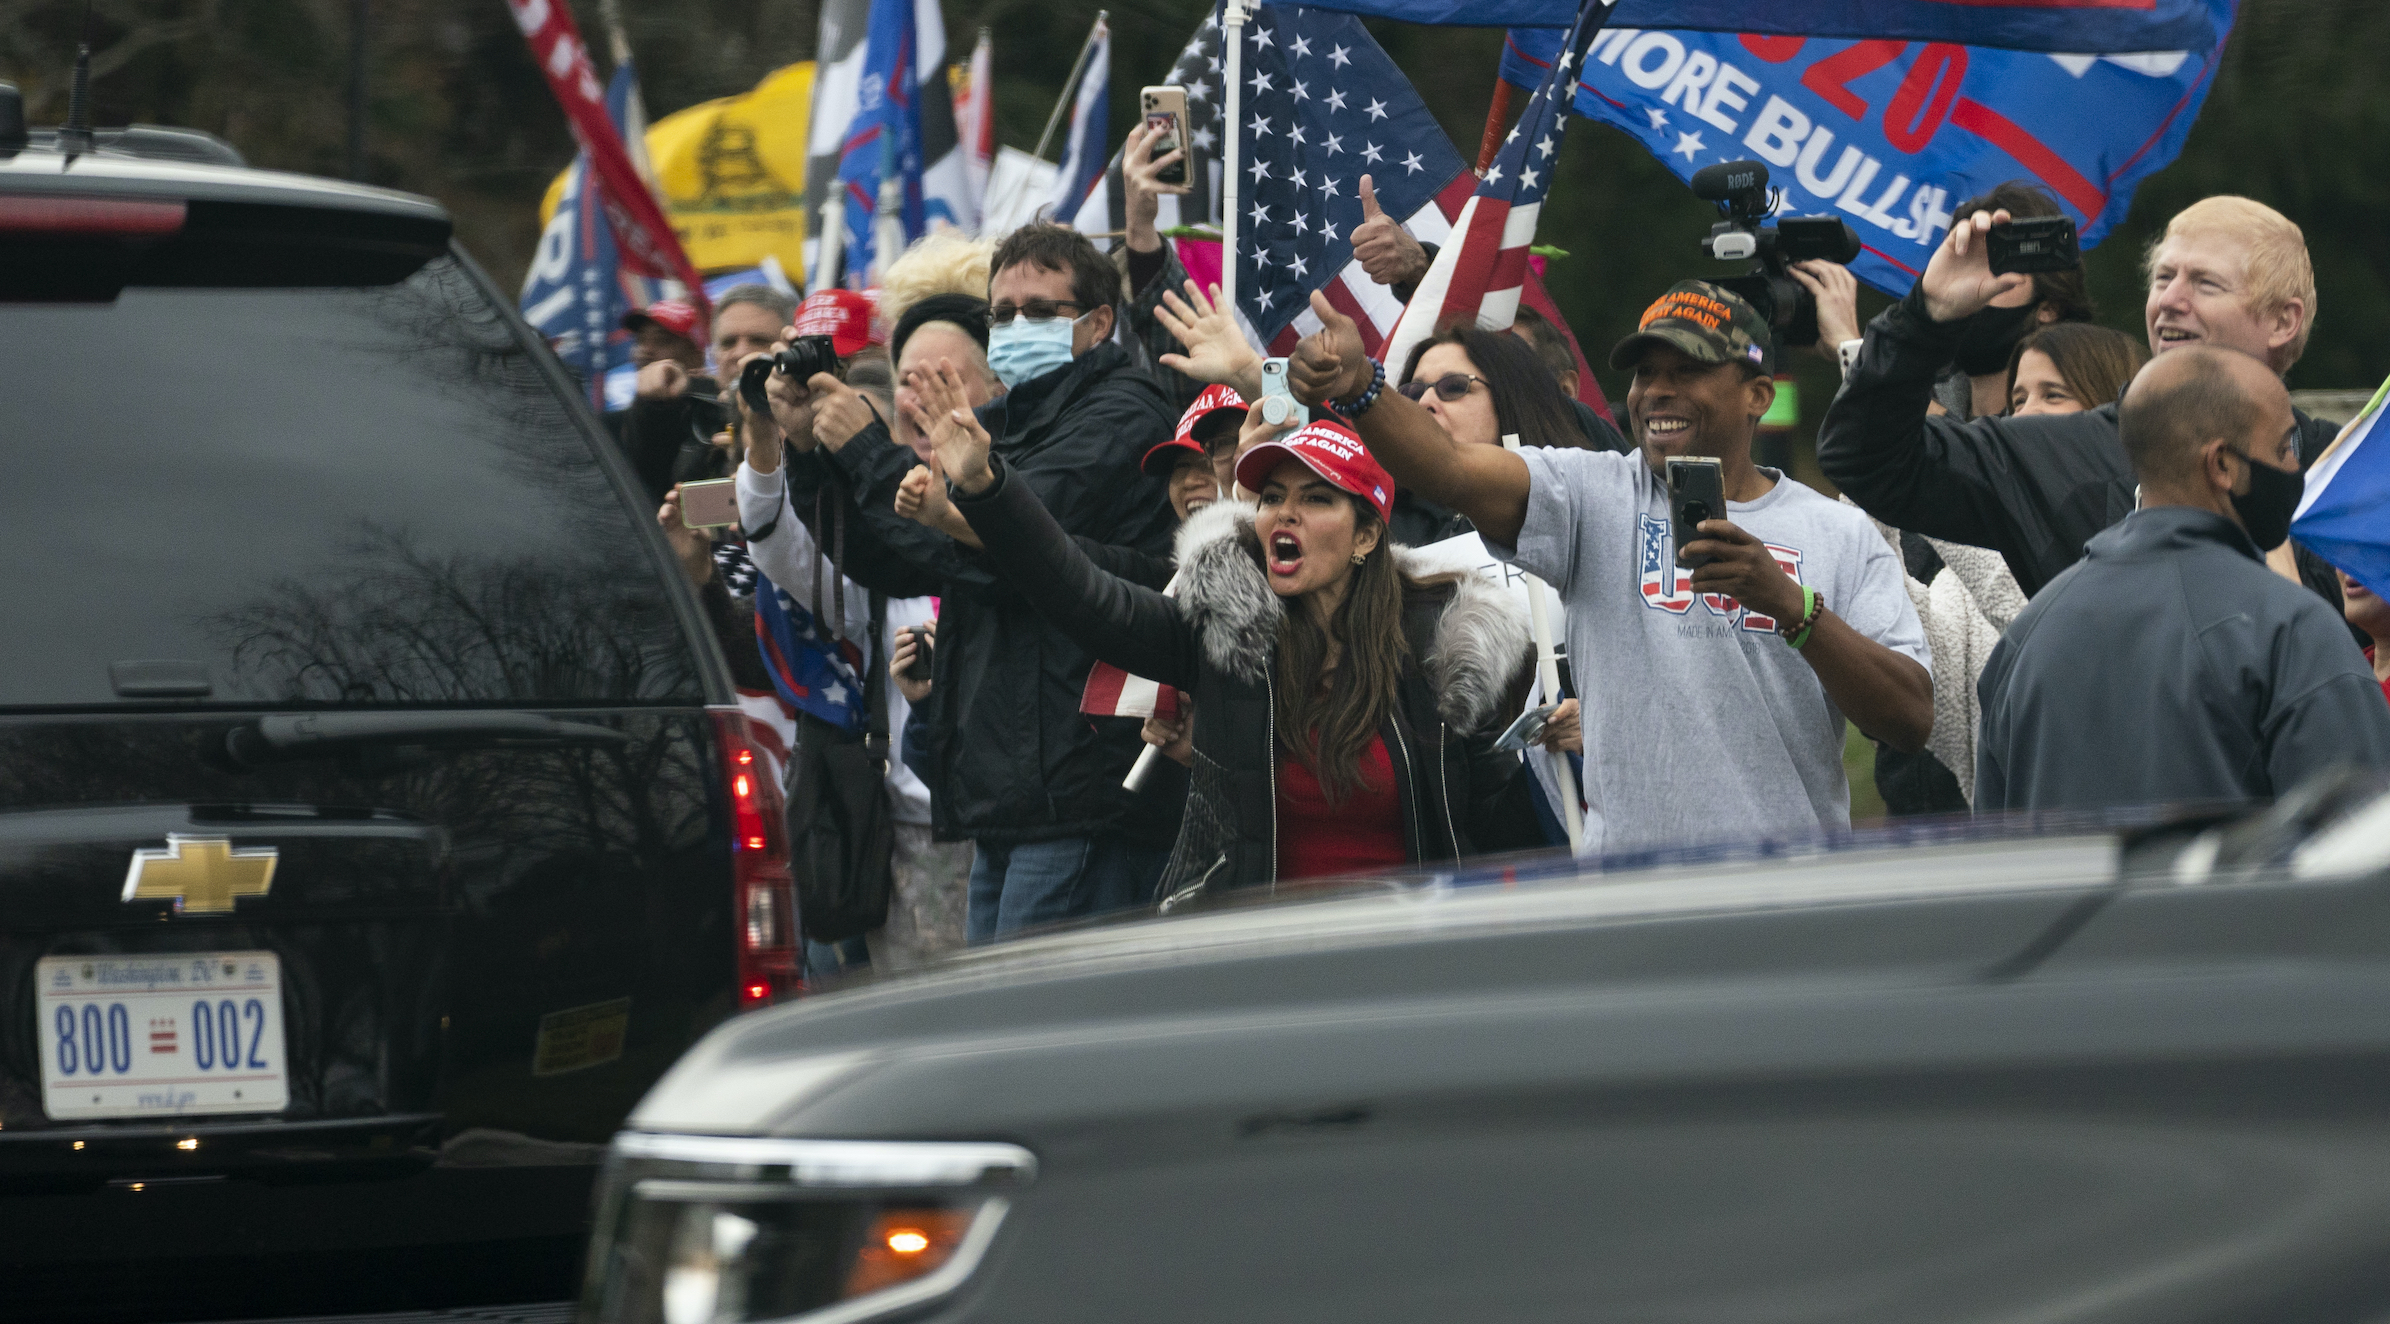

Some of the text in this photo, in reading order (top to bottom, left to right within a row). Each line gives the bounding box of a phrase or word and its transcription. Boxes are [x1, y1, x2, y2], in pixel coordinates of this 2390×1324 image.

[1727, 171, 1754, 190] RØDE
[1743, 95, 1956, 246] BULLSH
[1667, 291, 1731, 322] AMERICA
[1672, 306, 1720, 331] AGAIN
[1301, 426, 1364, 456] AMERICA
[1306, 438, 1353, 461] AGAIN
[55, 999, 267, 1076] 800 002
